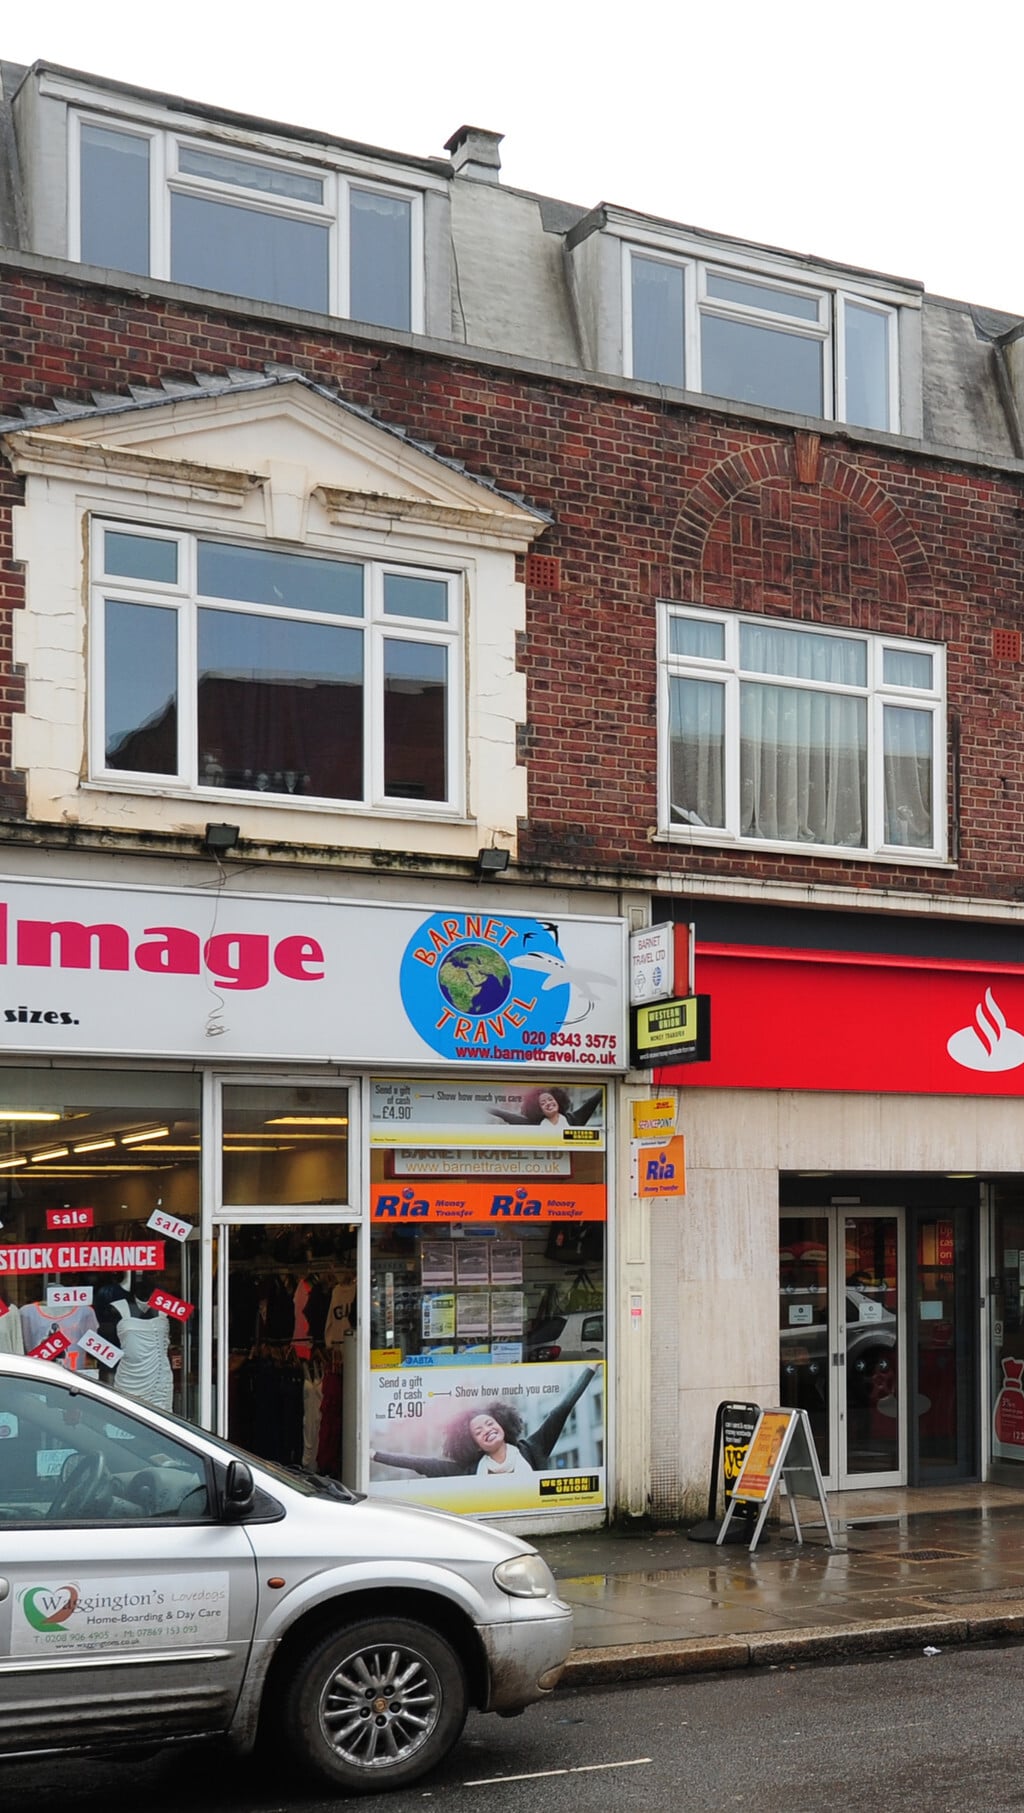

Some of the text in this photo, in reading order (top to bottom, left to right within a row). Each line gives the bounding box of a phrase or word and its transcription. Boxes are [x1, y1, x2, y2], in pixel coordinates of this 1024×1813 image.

[0, 903, 325, 990] mage
[412, 915, 519, 967] BARNET
[638, 935, 661, 950] BARNET
[633, 950, 666, 966] TRAVEL LTD
[4, 1006, 80, 1025] sizes.
[435, 996, 538, 1044] TRAVEL
[649, 1007, 680, 1022] WESTERN
[658, 1017, 681, 1031] UNION
[522, 1030, 617, 1048] 020 8343 3575
[455, 1045, 617, 1065] www.barnettravel.co.uk
[375, 1085, 392, 1095] Send
[399, 1086, 411, 1097] gift
[437, 1090, 456, 1101] Show
[458, 1092, 473, 1102] how
[474, 1093, 493, 1103] much
[494, 1095, 506, 1105] you
[387, 1096, 411, 1106] of cash
[406, 1161, 561, 1173] www.barnettravel.co.uk
[646, 1154, 675, 1180] Ria
[375, 1189, 430, 1217] Ria
[435, 1200, 466, 1208] Money
[490, 1189, 542, 1217] Ria
[547, 1200, 576, 1208] Money
[52, 1211, 88, 1225] sale
[435, 1209, 474, 1217] Transfer
[547, 1209, 583, 1217] Transfer
[154, 1216, 186, 1237] sale
[0, 1246, 157, 1270] STOCK CLEARANCE
[53, 1290, 87, 1303] sale
[154, 1295, 187, 1317] sale
[86, 1336, 115, 1361] sale
[413, 1357, 434, 1365] ABTA
[379, 1376, 422, 1388] Send a gift
[393, 1389, 422, 1400] of cash
[455, 1384, 560, 1398] Show how much you care
[388, 1401, 422, 1419] £4.90
[541, 1478, 588, 1487] WESTERN
[556, 1484, 588, 1493] UNION
[41, 1590, 165, 1614] Waggington's
[87, 1608, 221, 1625] Home-Boarding & Day Care
[69, 1632, 86, 1641] 906
